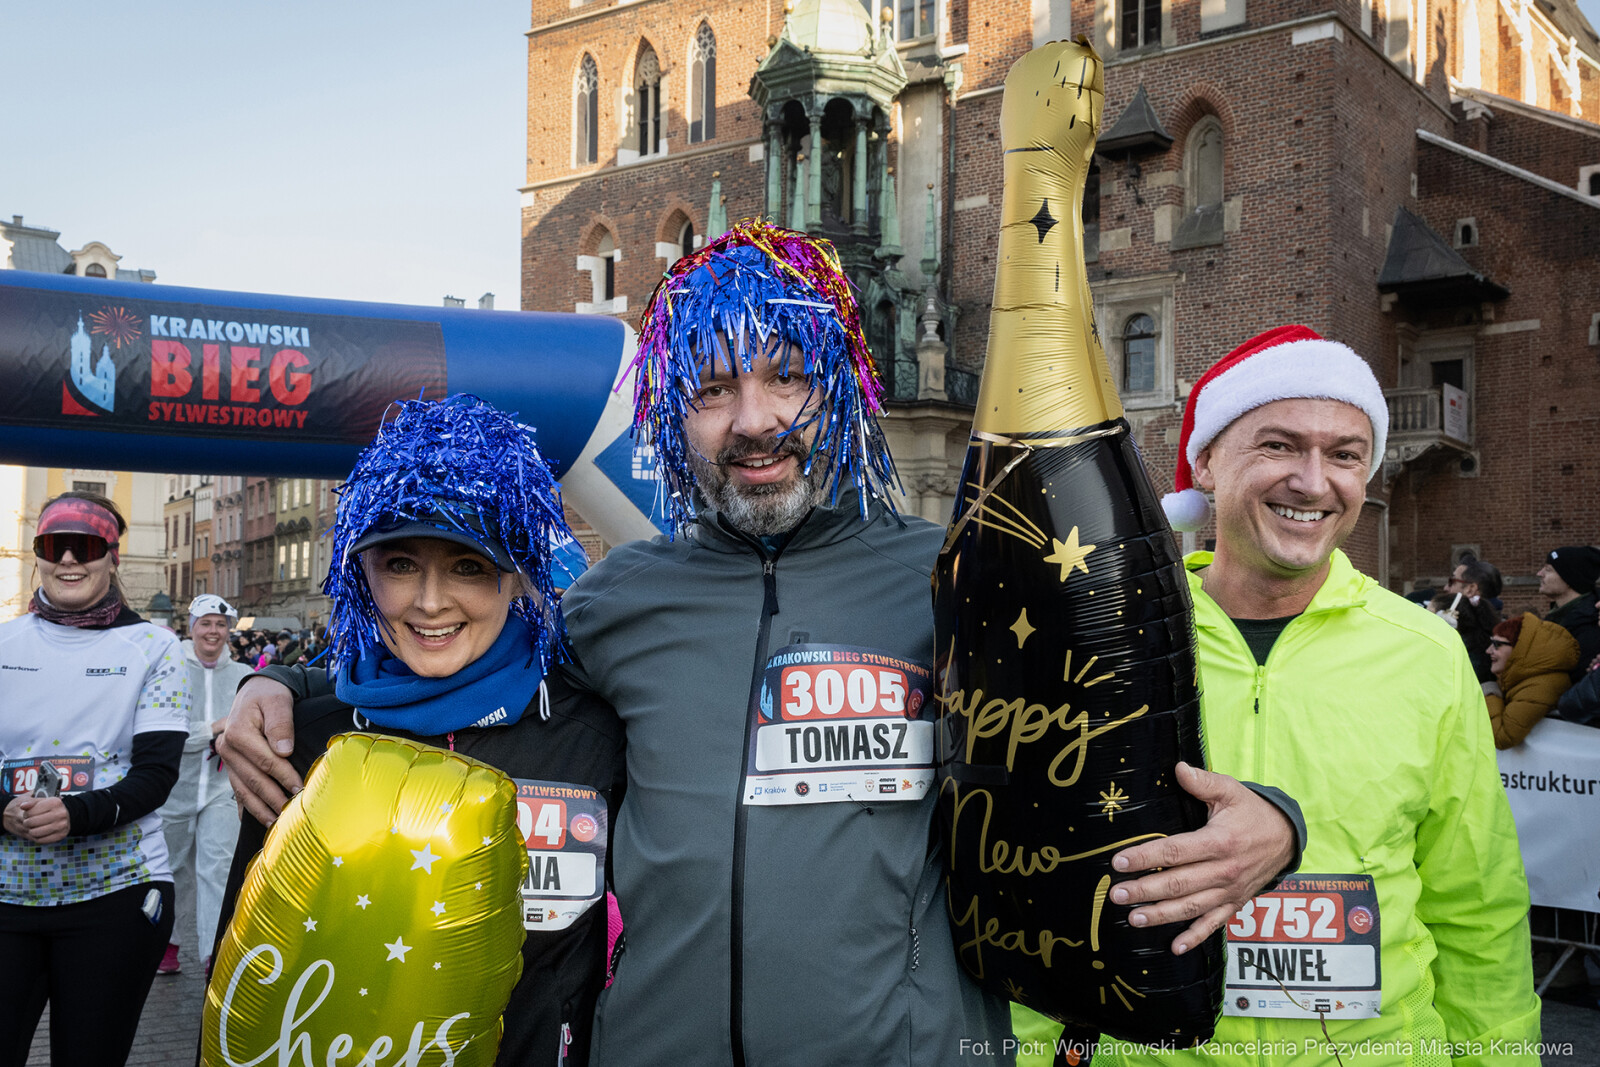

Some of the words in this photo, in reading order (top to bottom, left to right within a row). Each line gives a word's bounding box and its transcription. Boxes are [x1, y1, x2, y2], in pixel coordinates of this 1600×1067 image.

[150, 314, 310, 347] KRAKOWSKI
[150, 339, 312, 406] BIEG
[148, 401, 309, 429] SYLWESTROWY
[773, 651, 831, 667] KRAKOWSKI
[833, 651, 860, 662] BIEG
[862, 653, 930, 679] SYLWESTROWY
[785, 668, 905, 716] 3005
[785, 723, 909, 763] TOMASZ
[15, 767, 70, 792] 206
[523, 785, 597, 800] SYLWESTROWY
[1500, 770, 1600, 795] astruktur
[939, 776, 1168, 877] New
[1298, 880, 1369, 891] SYLWESTROWY
[1229, 897, 1338, 939] 3752
[1237, 947, 1332, 982] PAWEŁ
